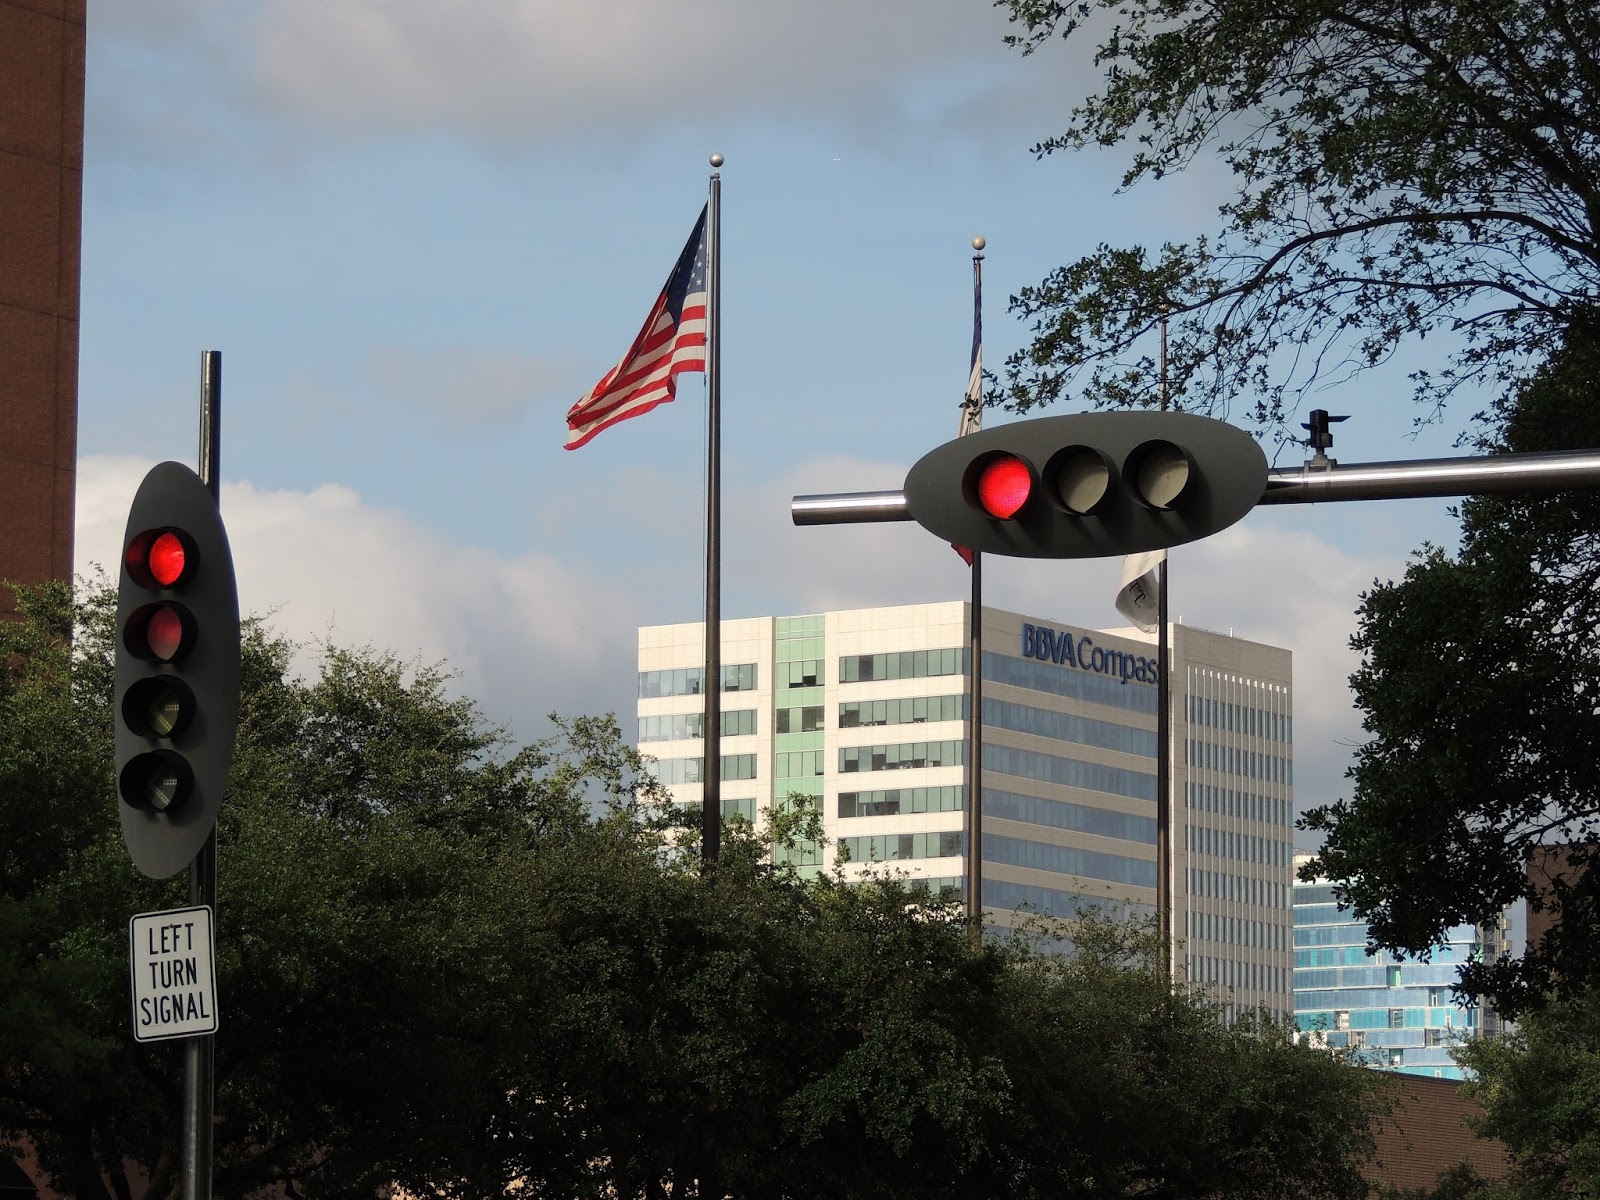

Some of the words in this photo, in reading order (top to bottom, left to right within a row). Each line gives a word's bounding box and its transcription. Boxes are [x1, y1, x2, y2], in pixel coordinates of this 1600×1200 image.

[1022, 623, 1076, 667] BBVA
[1078, 637, 1160, 684] Compas
[149, 923, 194, 955] LEFT
[149, 957, 197, 989] TURN
[141, 991, 210, 1026] SIGNAL
